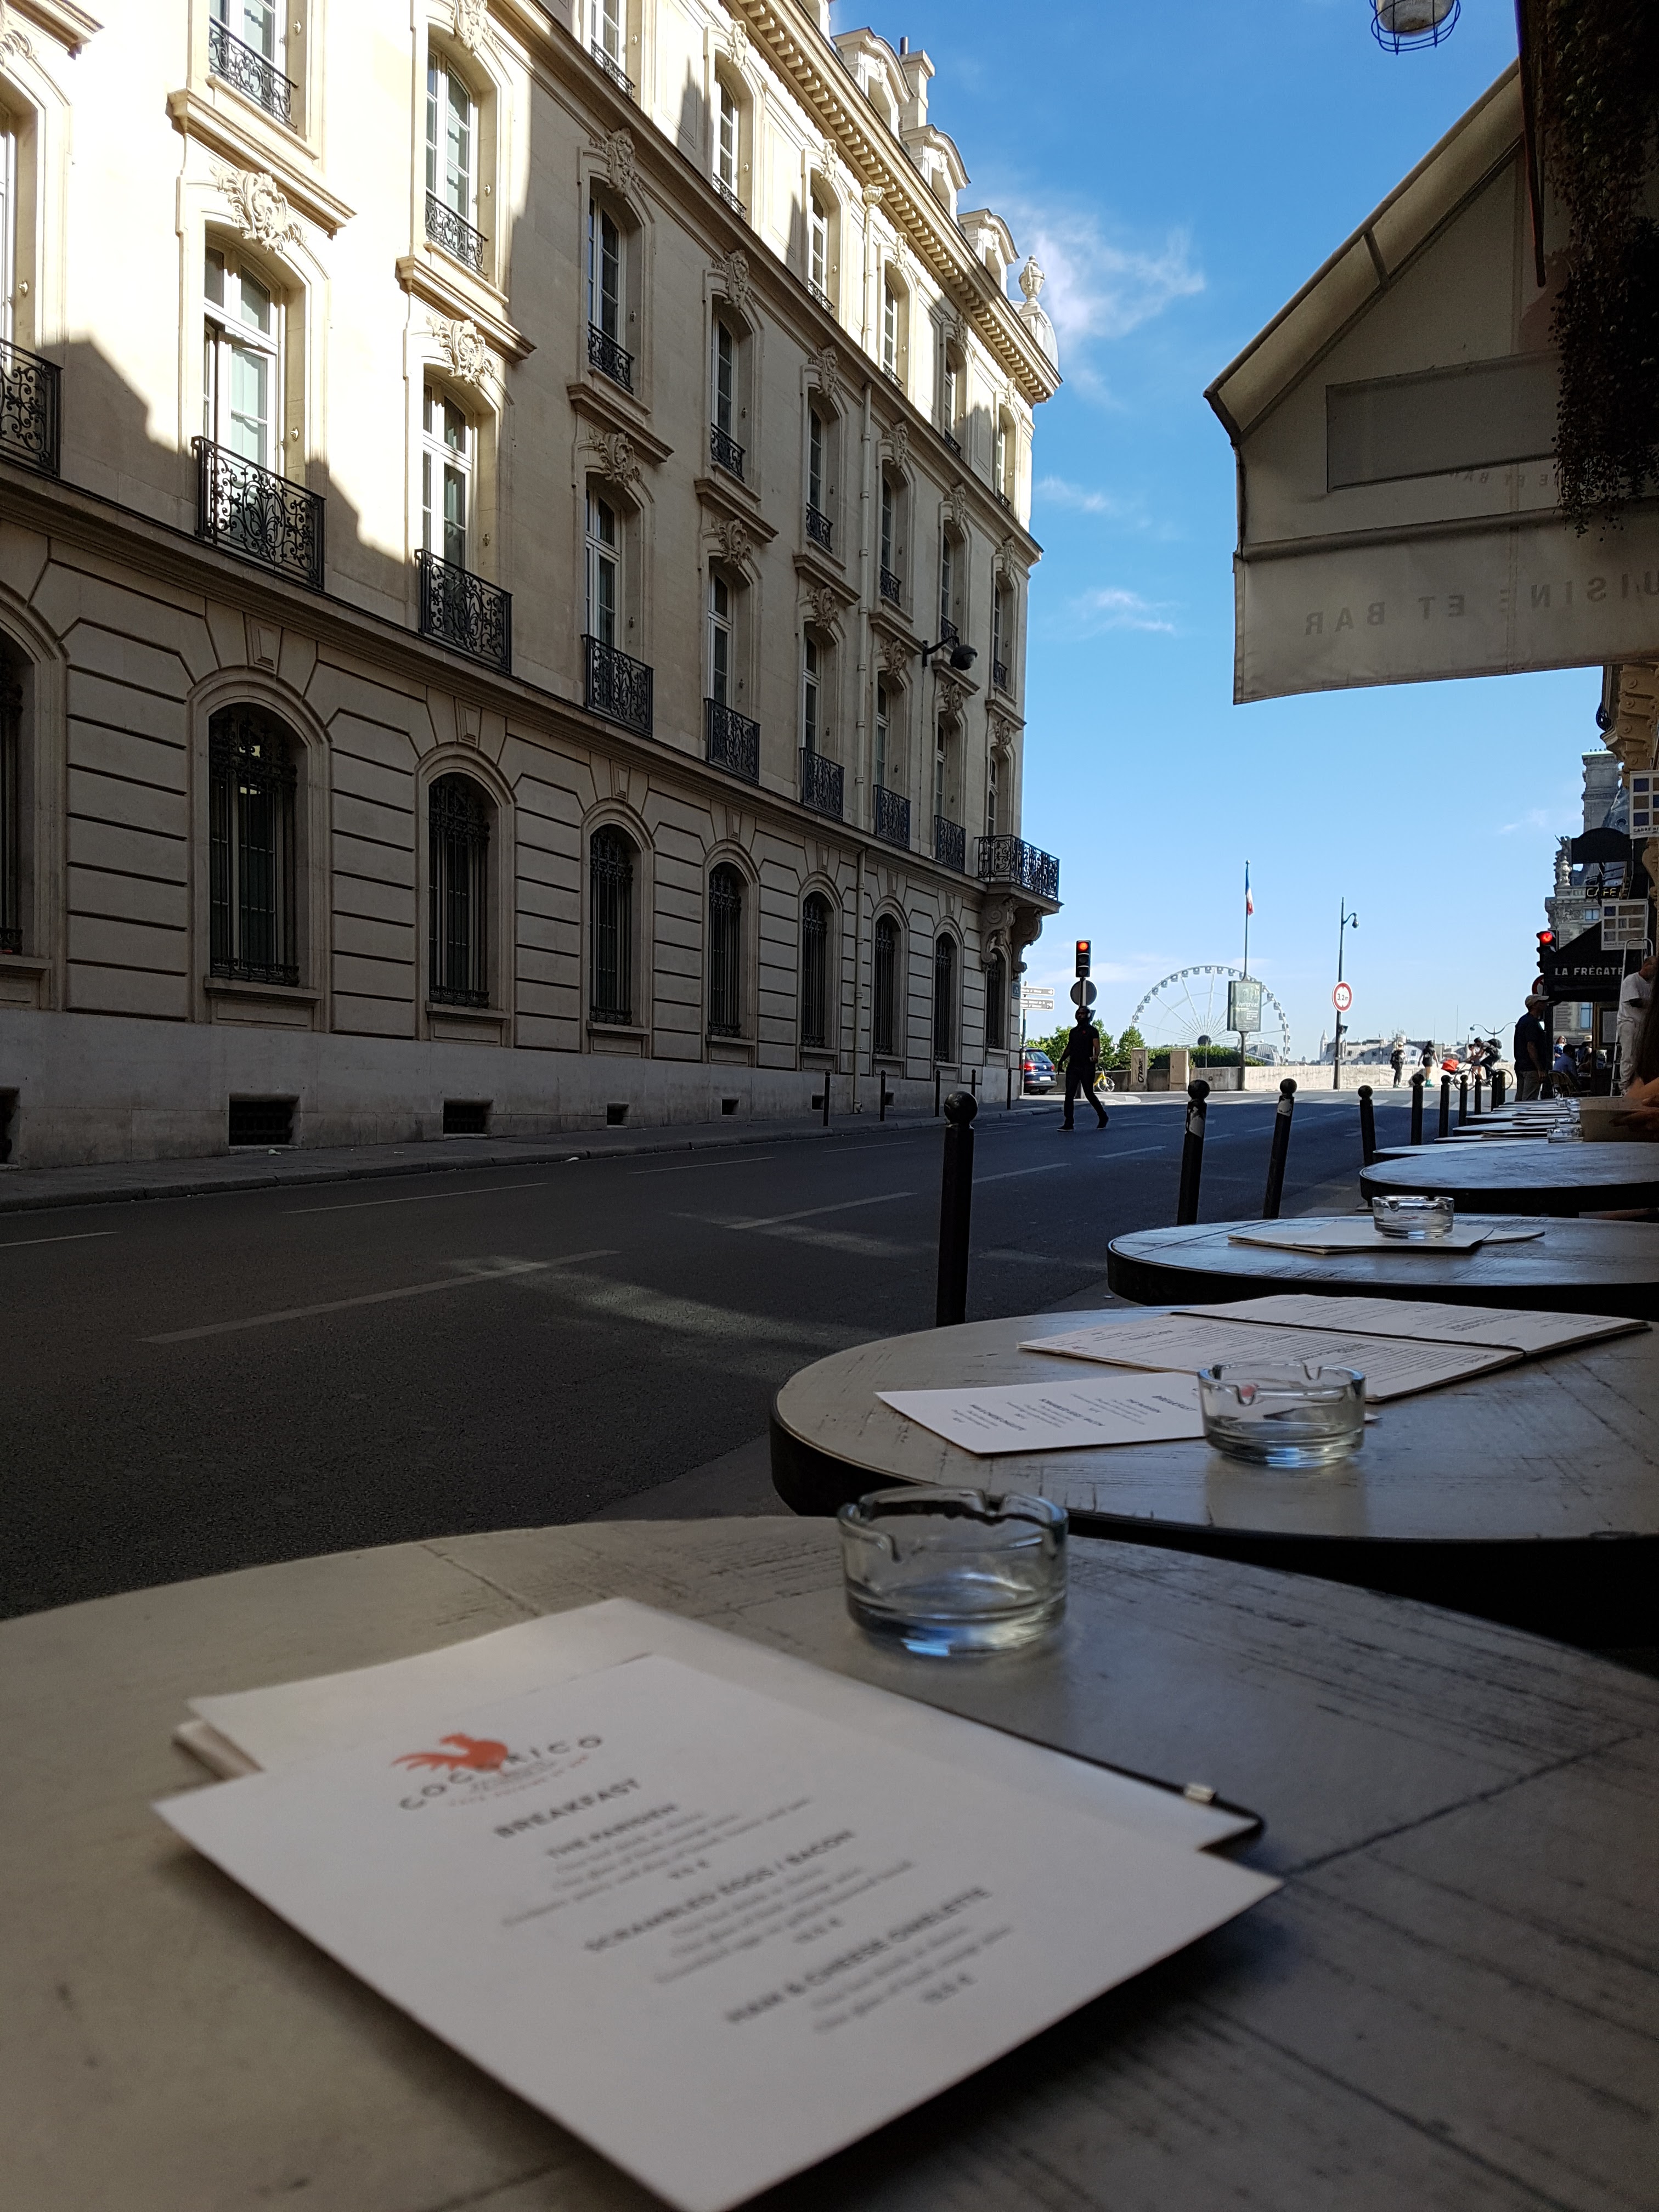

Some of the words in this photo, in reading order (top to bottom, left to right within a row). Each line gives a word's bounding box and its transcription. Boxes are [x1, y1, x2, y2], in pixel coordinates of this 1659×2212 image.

[1555, 967, 1568, 975] LA
[399, 1735, 601, 1810] COCRICO
[493, 1778, 639, 1838] BREAKFAST
